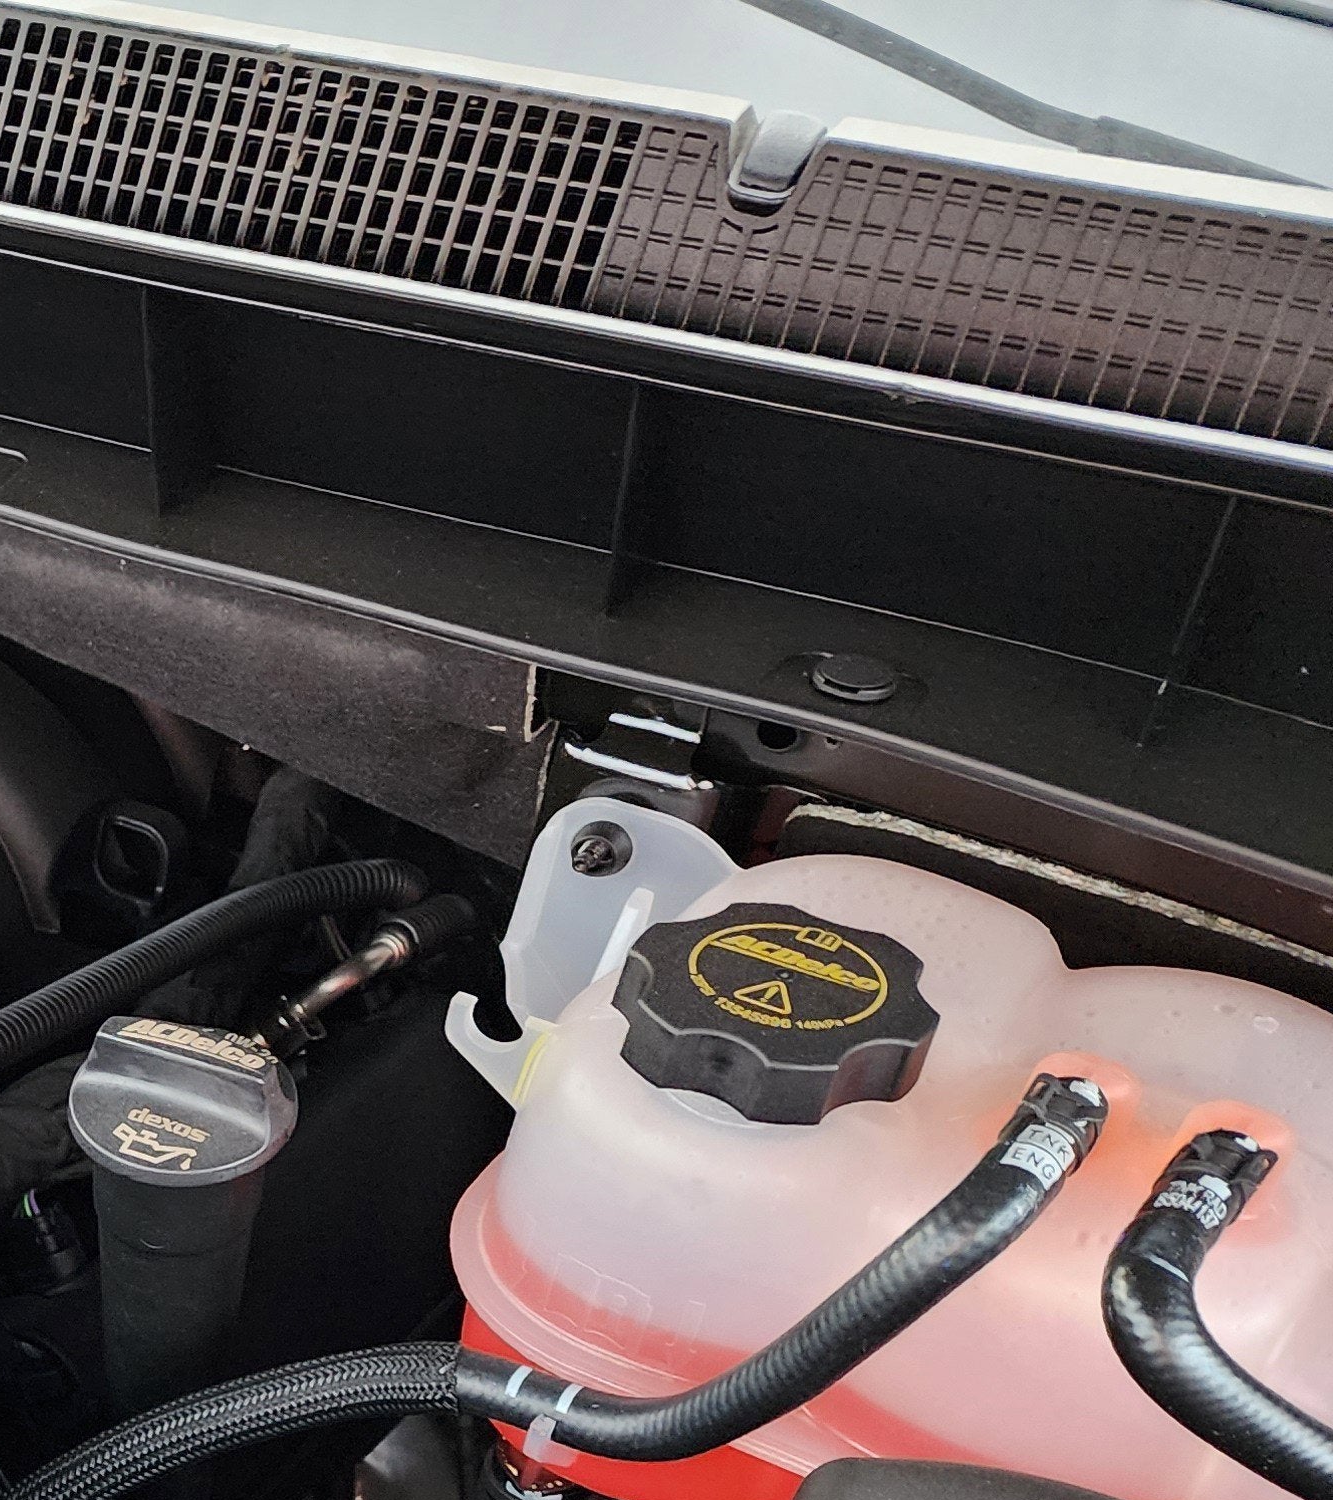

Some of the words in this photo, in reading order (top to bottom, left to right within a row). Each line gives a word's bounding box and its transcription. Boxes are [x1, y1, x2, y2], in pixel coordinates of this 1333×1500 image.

[718, 934, 881, 991] ACDelco
[119, 1018, 266, 1070] ACDelco
[127, 1107, 212, 1143] dexos
[1011, 1146, 1055, 1180] ENG
[1028, 1128, 1070, 1163] TNK
[1202, 1189, 1228, 1221] RAD
